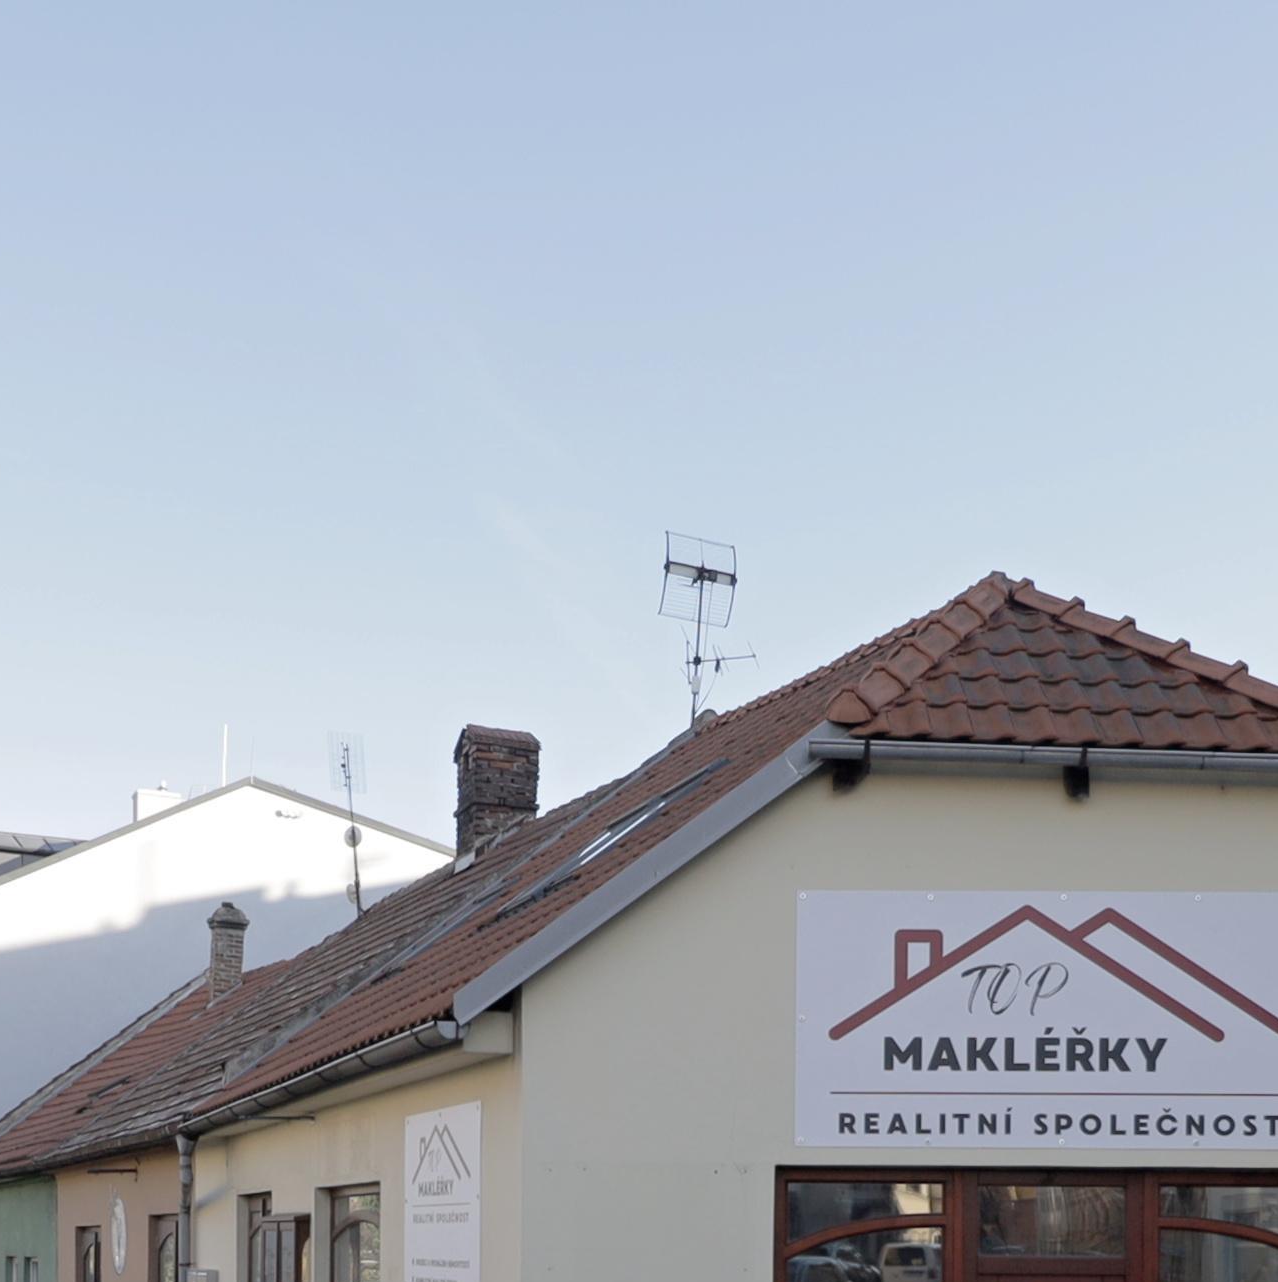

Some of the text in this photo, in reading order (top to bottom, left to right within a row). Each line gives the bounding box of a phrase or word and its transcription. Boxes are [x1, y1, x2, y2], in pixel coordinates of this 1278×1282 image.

[961, 962, 1069, 1016] TOP
[883, 1026, 1169, 1073] MAKLÉŘKY
[838, 1107, 1013, 1136] REALITNÍ
